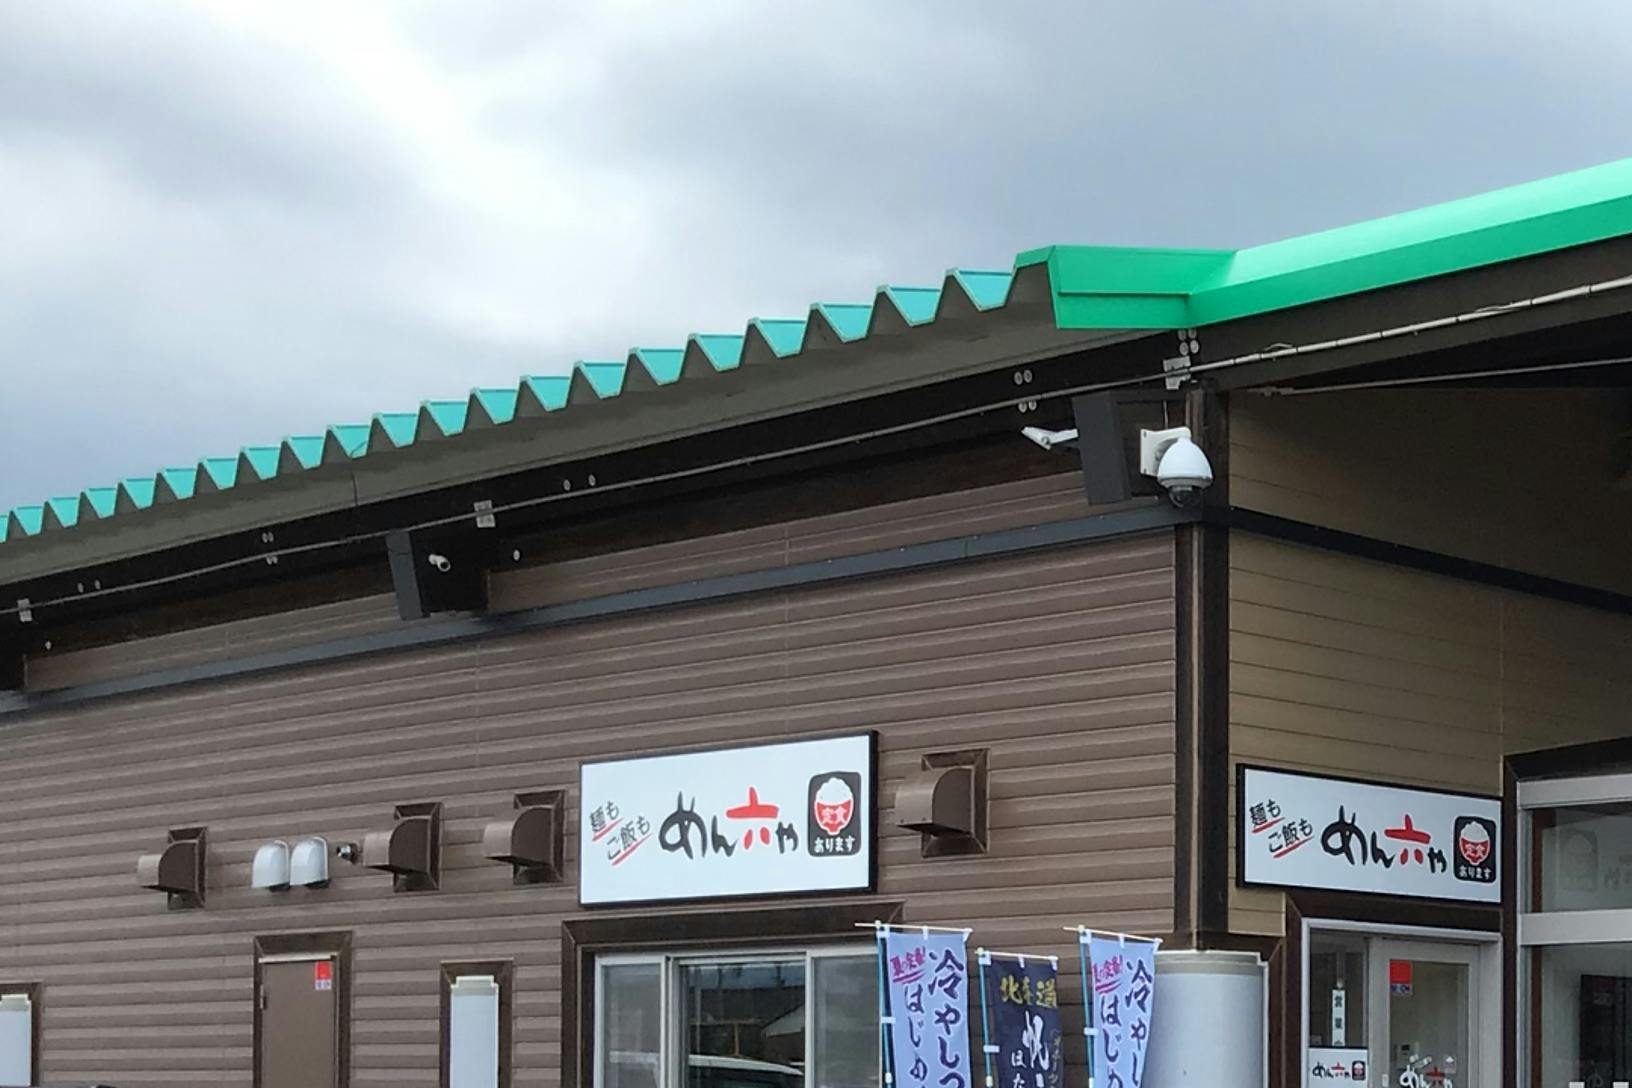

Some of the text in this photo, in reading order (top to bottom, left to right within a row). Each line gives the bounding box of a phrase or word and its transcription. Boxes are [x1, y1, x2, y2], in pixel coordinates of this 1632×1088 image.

[590, 800, 620, 832] 麺も
[658, 786, 799, 860] めん六や
[1249, 799, 1281, 827] 麺も
[607, 815, 650, 860] ご飯も
[814, 835, 856, 854] あります
[1268, 818, 1313, 853] ご飯も
[1321, 805, 1447, 873] めん六や
[1459, 865, 1491, 880] あります
